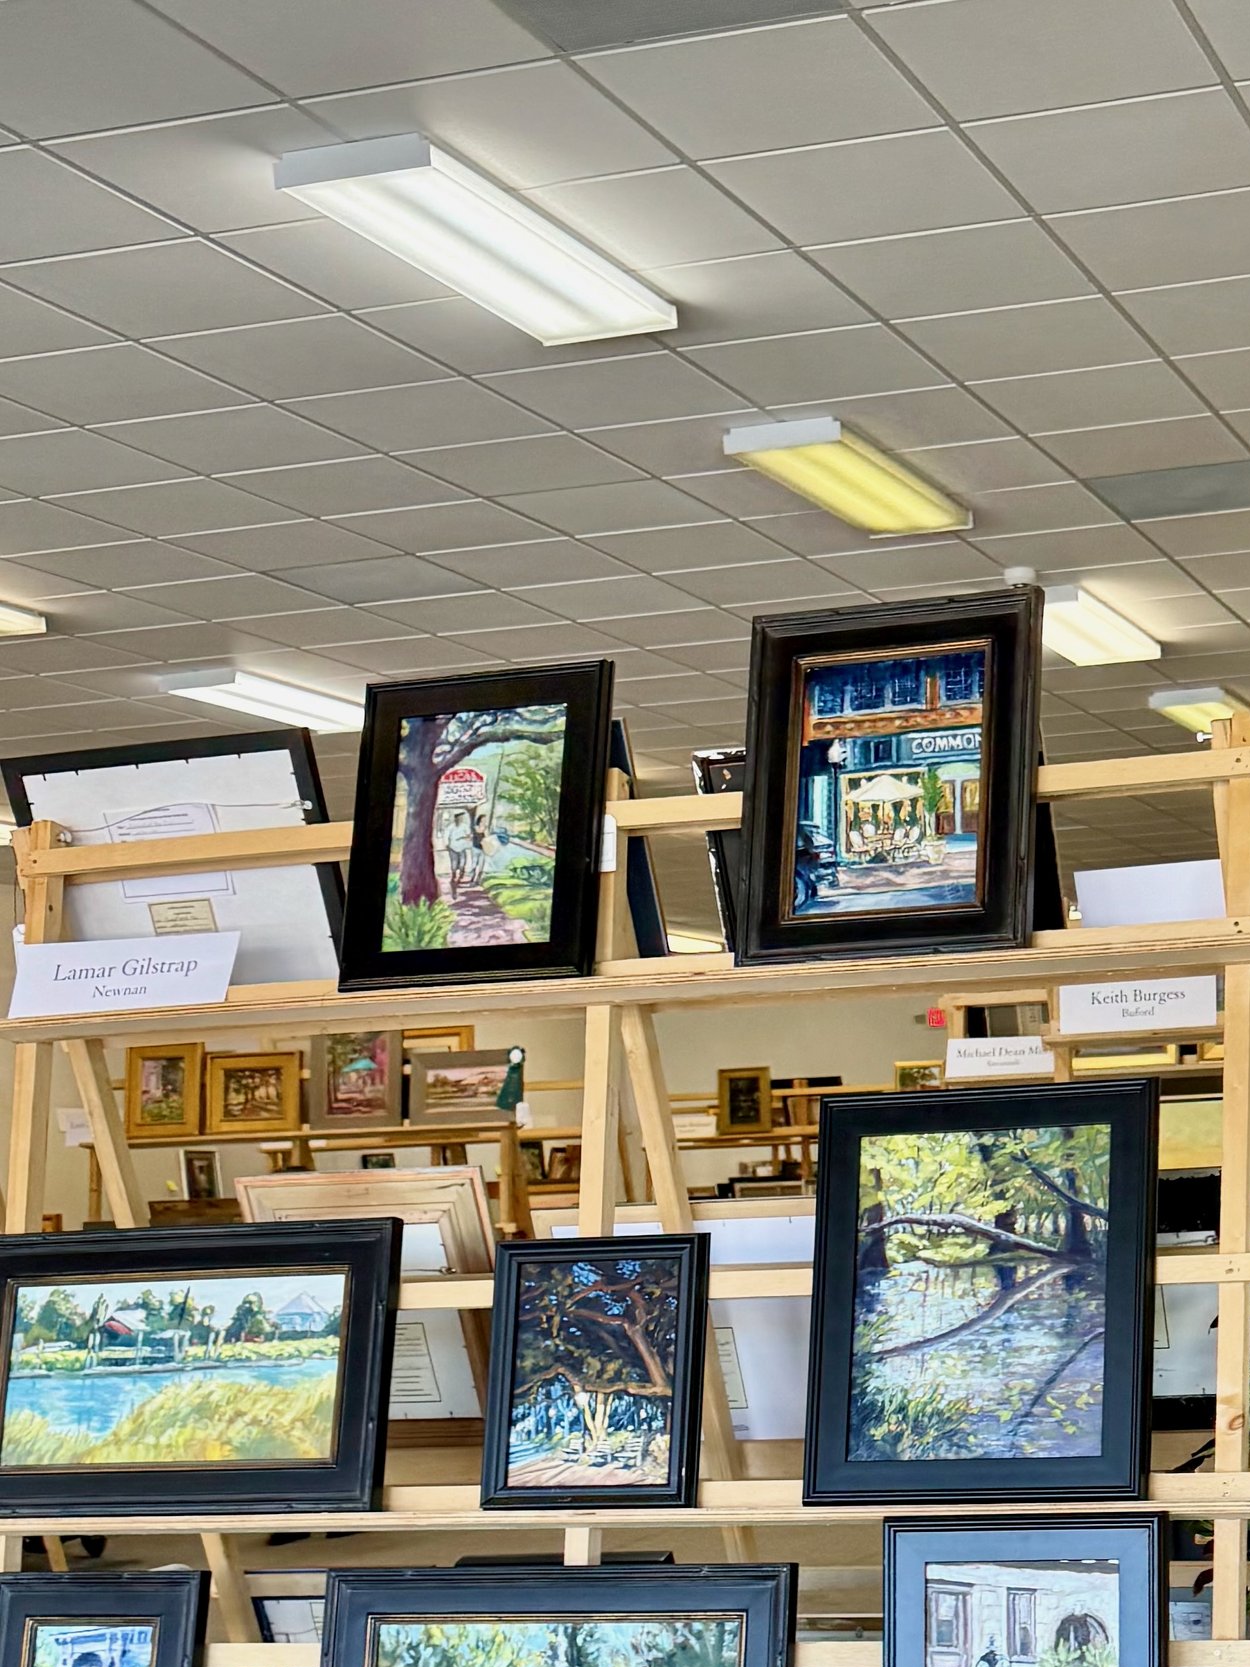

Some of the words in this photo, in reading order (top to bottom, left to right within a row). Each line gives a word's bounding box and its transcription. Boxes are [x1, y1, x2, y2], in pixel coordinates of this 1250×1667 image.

[53, 964, 116, 981] Lamar
[122, 957, 198, 977] Gilstrap
[93, 984, 147, 998] Newnan
[1091, 991, 1128, 1005] Keith
[1133, 988, 1186, 1004] Burgess
